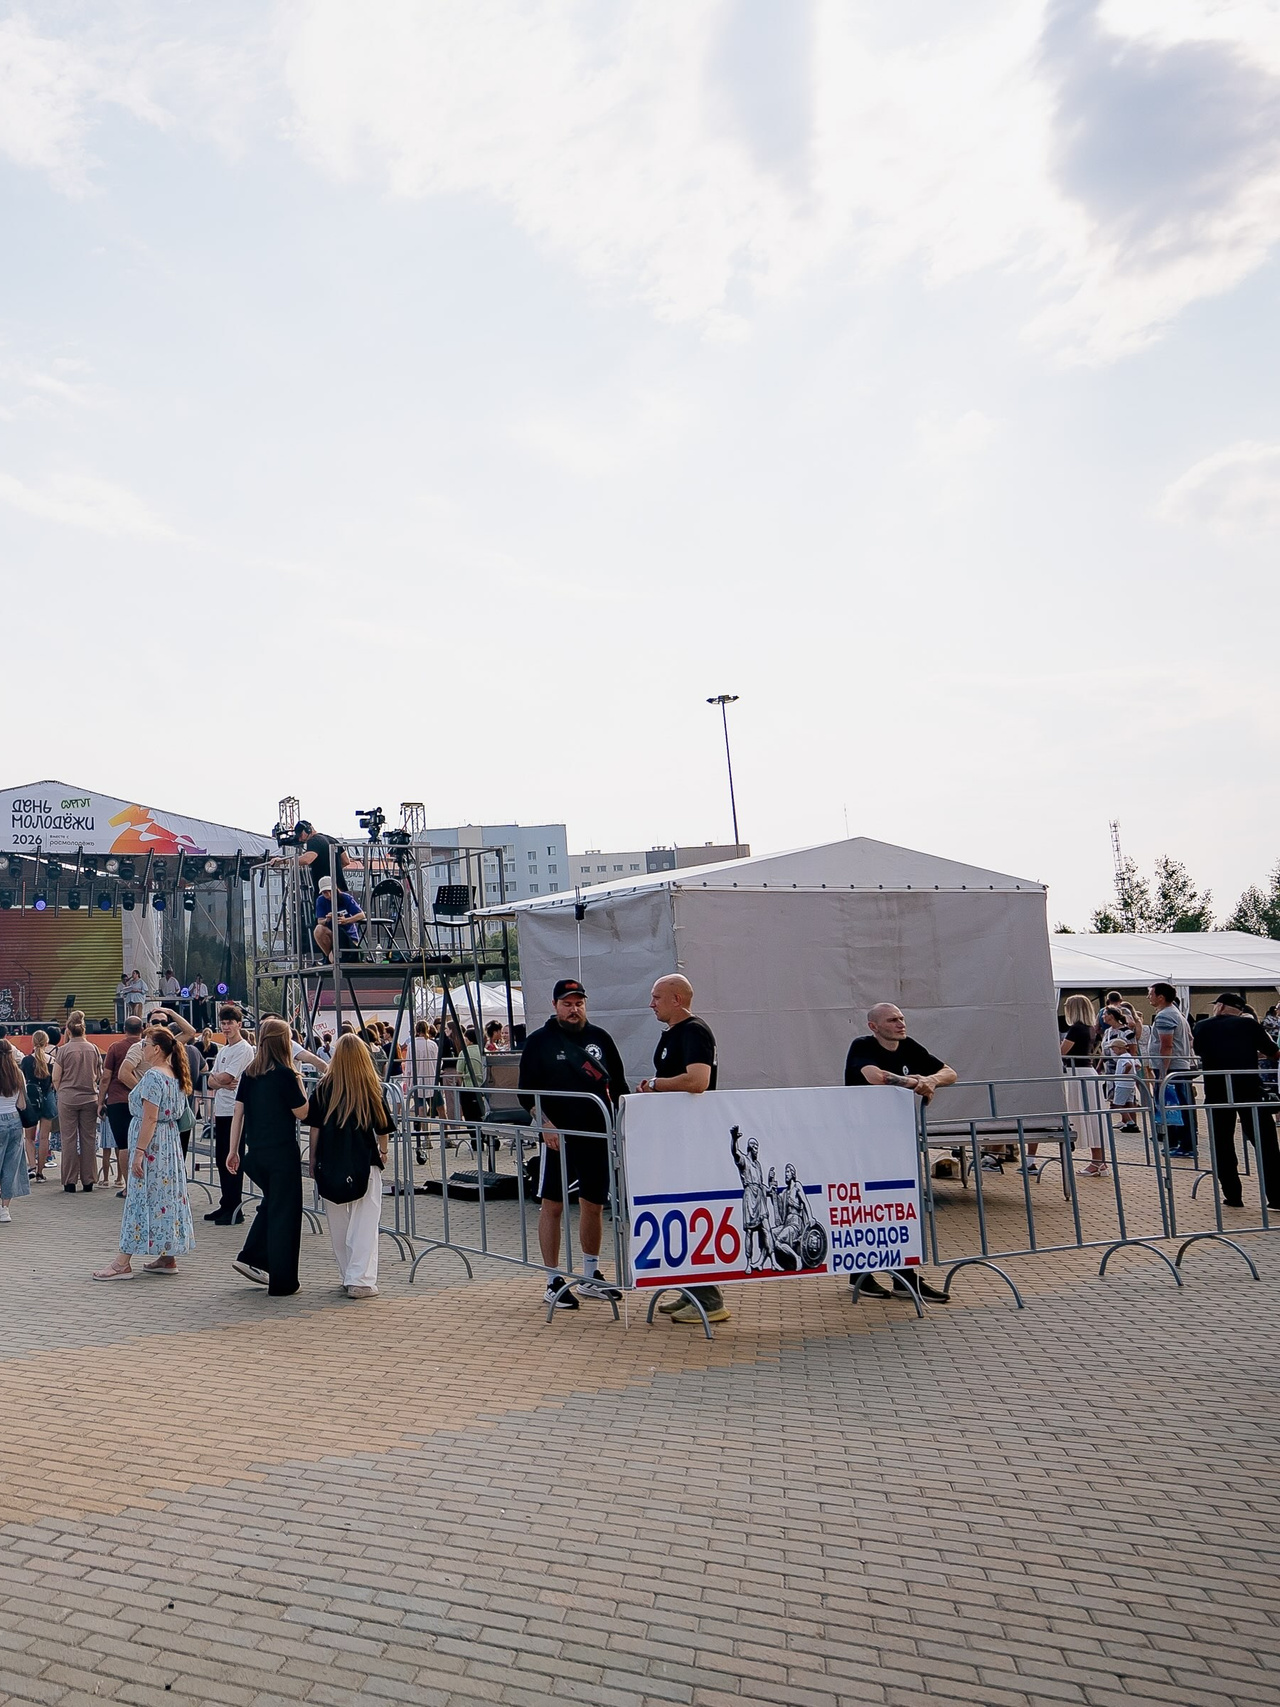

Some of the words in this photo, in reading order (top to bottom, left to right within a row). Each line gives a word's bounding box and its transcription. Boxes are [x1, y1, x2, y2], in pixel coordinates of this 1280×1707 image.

[61, 798, 91, 809] СУРГУТ
[12, 834, 42, 845] 2026
[827, 1182, 861, 1204] ГОД
[829, 1202, 917, 1228] ЕДИНСТВА
[633, 1206, 741, 1270] 2026
[831, 1225, 909, 1249] НАРОДОВ
[832, 1249, 901, 1272] РОССИИ
